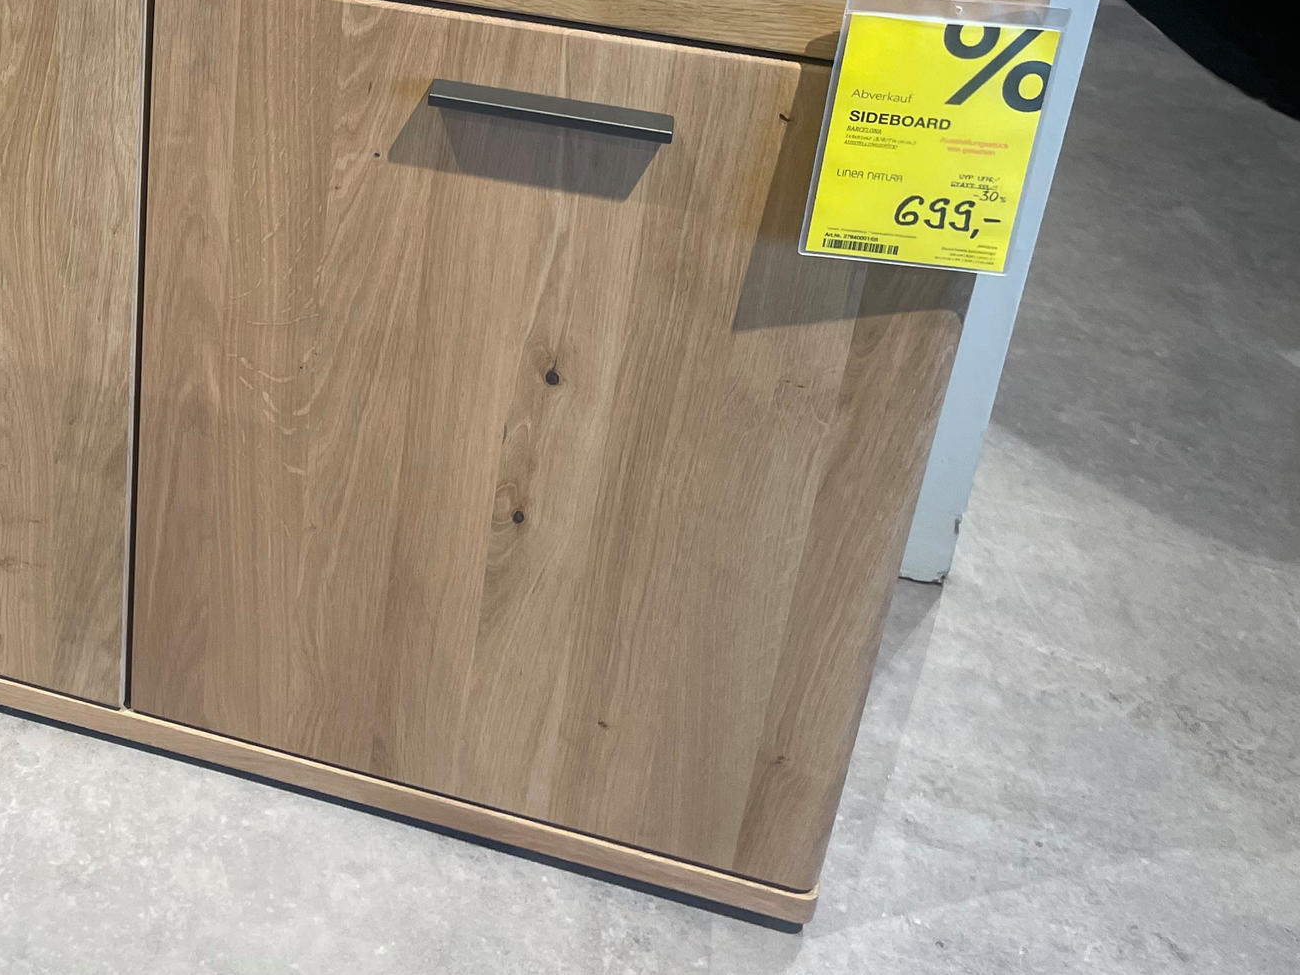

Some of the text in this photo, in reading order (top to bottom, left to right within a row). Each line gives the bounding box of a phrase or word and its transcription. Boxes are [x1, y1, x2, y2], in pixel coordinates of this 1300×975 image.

[944, 24, 1052, 112] %
[851, 89, 914, 104] Abverkauf
[849, 110, 952, 130] SIDEBOARD
[894, 195, 1001, 239] 699,-
